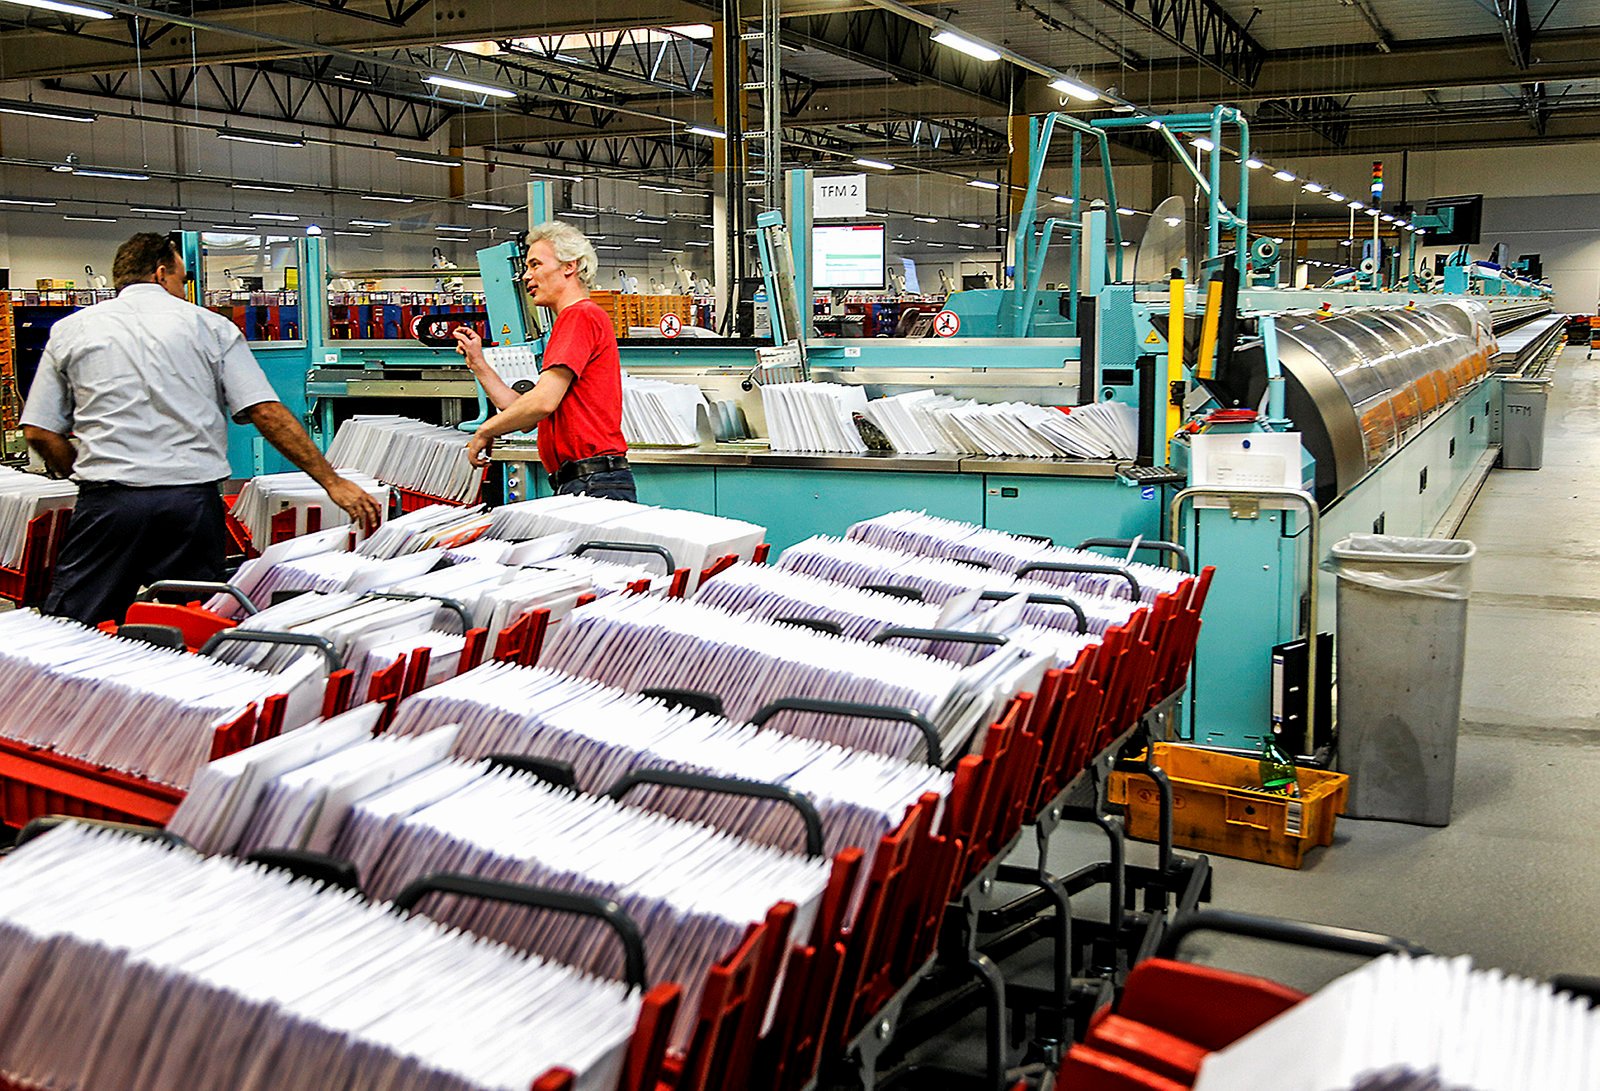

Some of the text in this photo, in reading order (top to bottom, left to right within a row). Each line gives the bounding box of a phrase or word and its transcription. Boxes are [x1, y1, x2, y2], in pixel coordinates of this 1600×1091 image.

[820, 184, 858, 198] TFM 2
[1507, 404, 1533, 417] TFM
